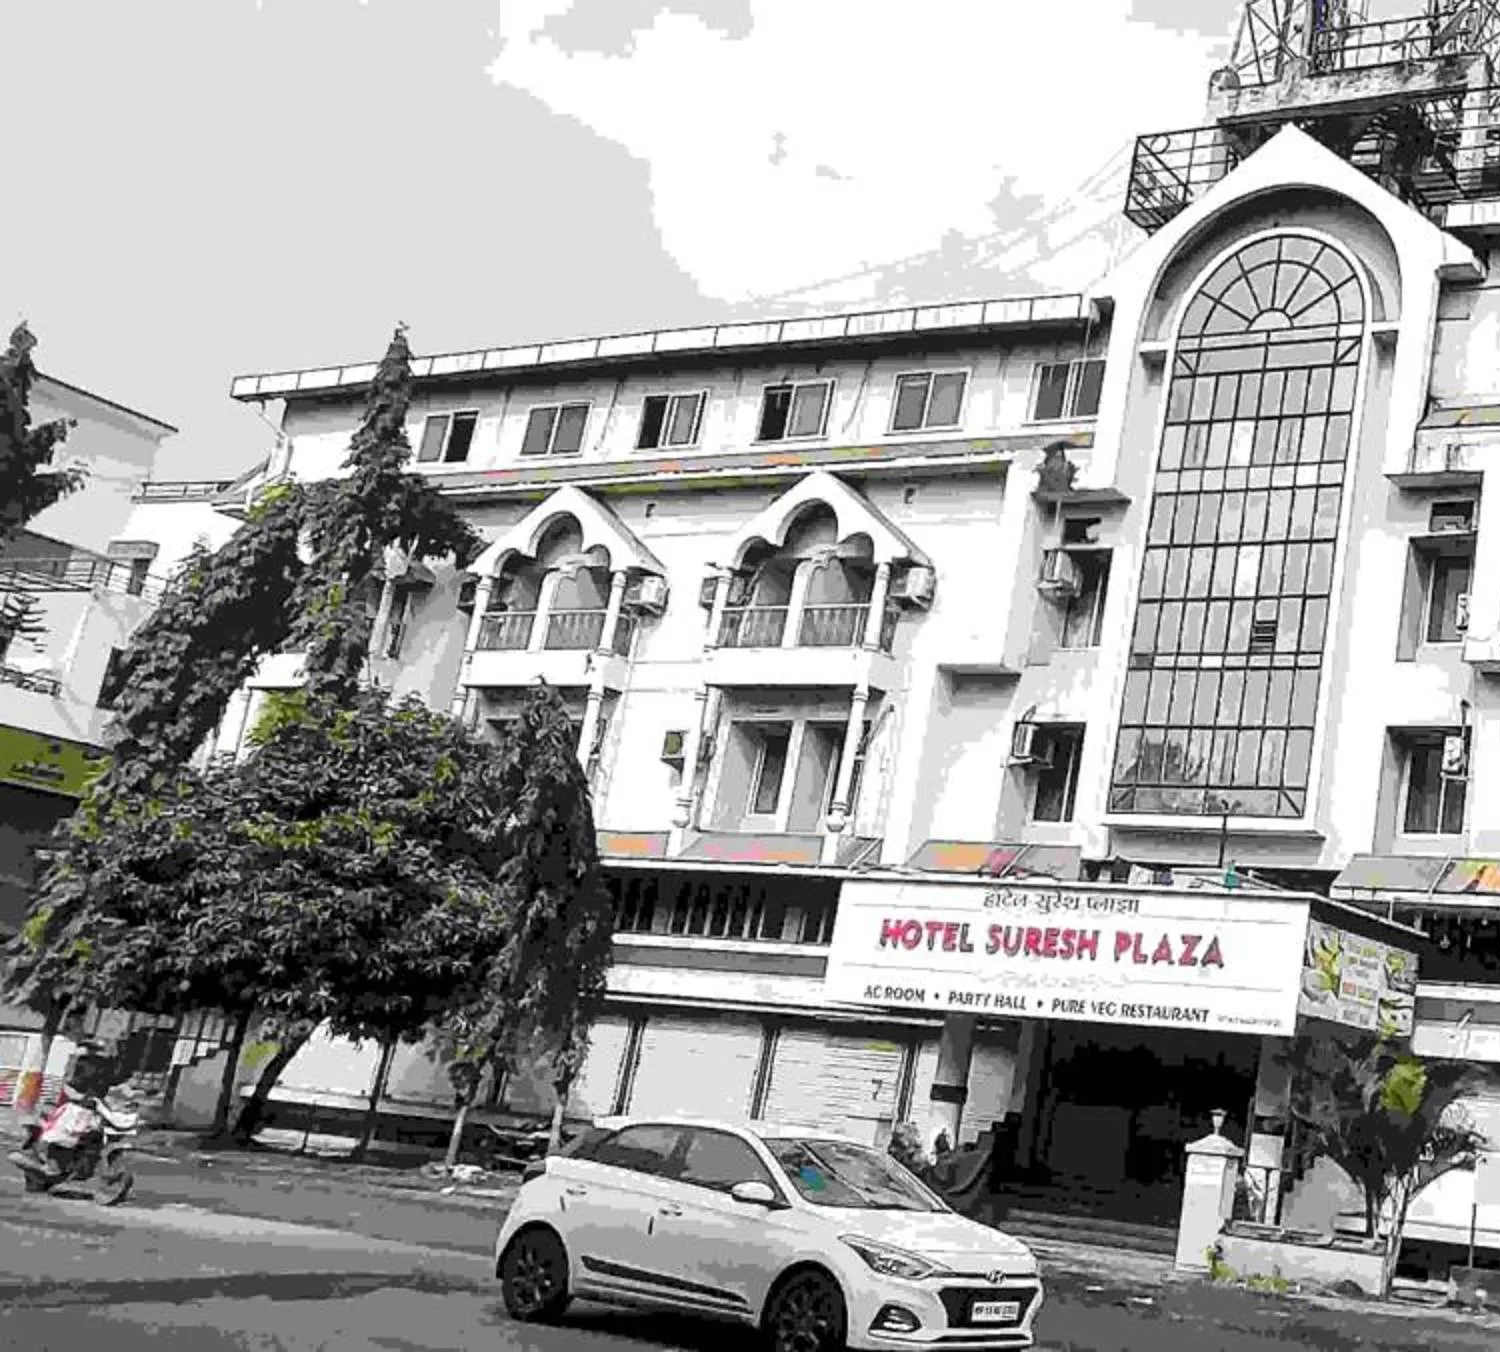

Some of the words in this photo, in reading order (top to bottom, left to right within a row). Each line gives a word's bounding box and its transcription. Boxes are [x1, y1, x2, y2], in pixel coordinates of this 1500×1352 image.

[1035, 889, 1081, 914] सुरेश
[879, 919, 974, 952] HOTEL
[985, 924, 1100, 960] SURESH
[1113, 930, 1225, 968] PLAZA
[864, 985, 882, 999] AC
[884, 986, 925, 1002] ROOM
[948, 990, 991, 1008] PARTY
[994, 993, 1027, 1011] HALL
[1052, 998, 1086, 1014] PURE
[1121, 1002, 1210, 1023] RESTAURANT
